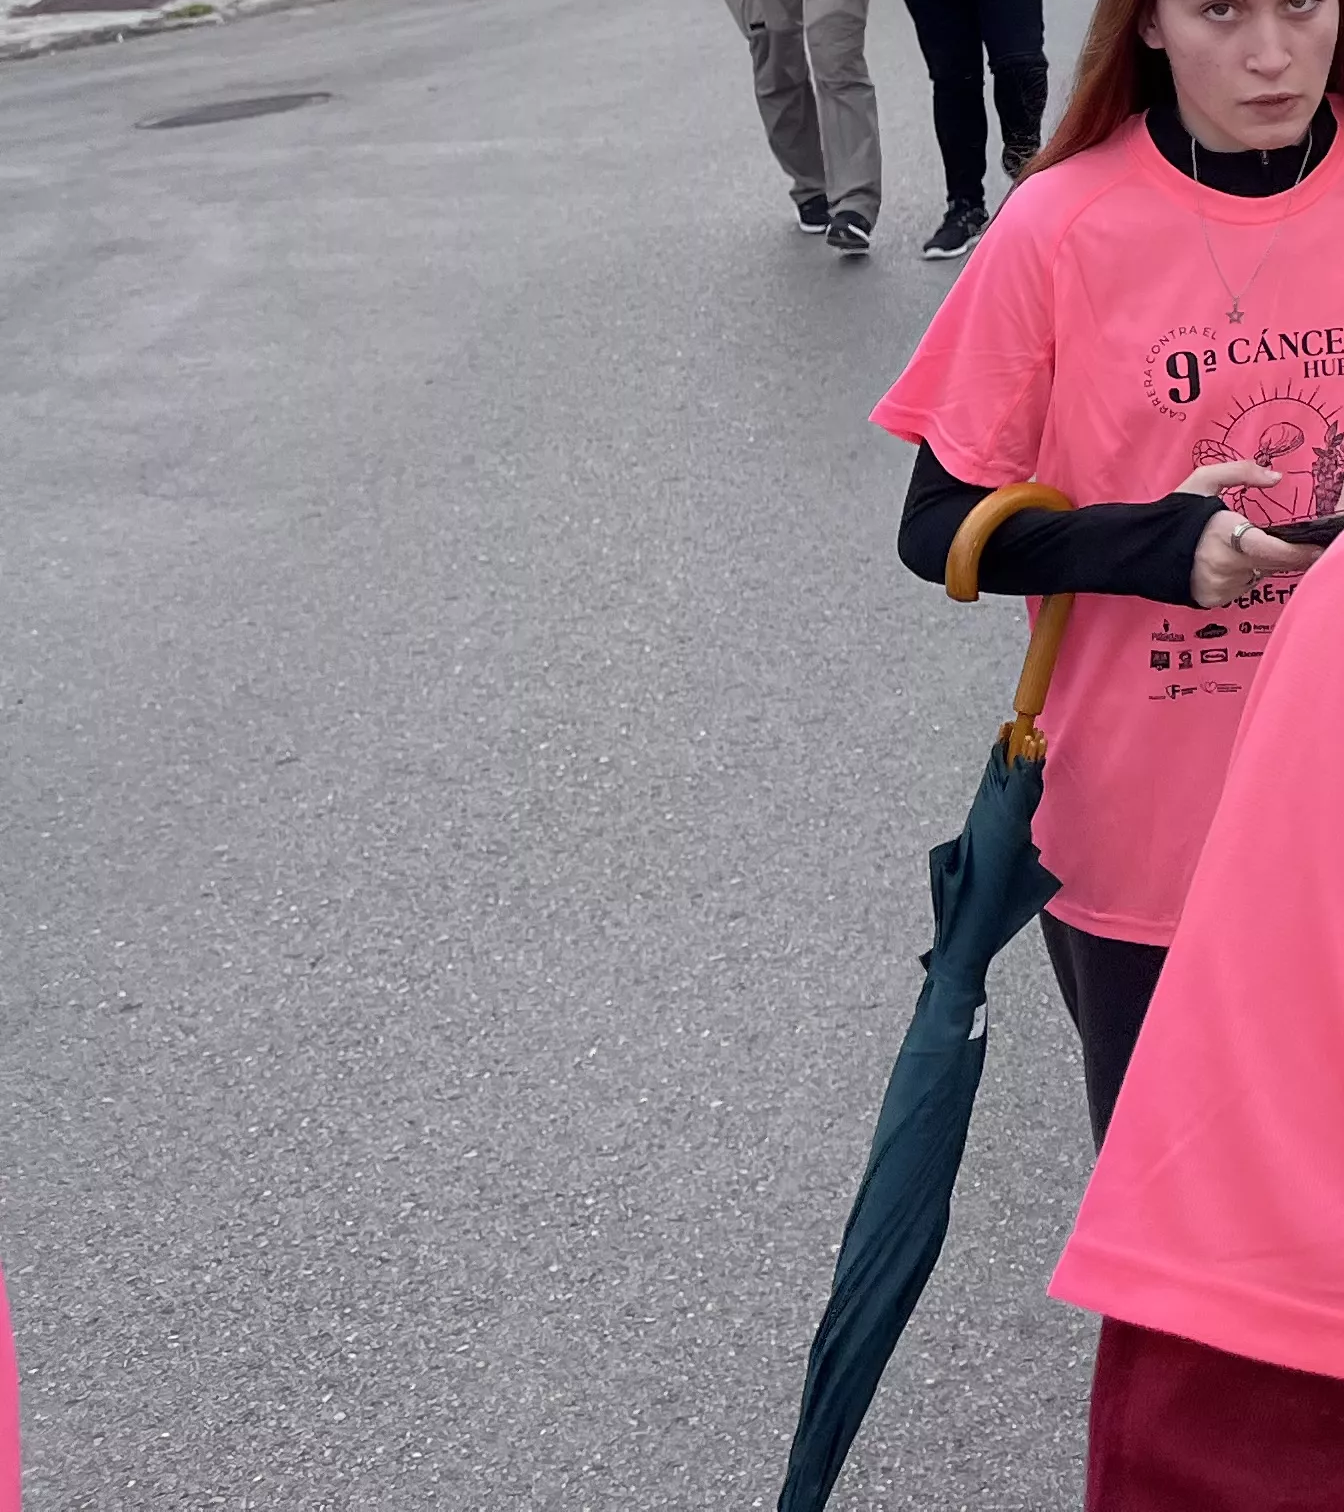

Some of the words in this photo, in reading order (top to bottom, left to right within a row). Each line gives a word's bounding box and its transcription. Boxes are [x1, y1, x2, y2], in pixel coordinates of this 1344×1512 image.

[1145, 325, 1199, 365] CONTRA
[1201, 325, 1218, 341] EL
[1143, 368, 1188, 423] CARRERA
[1165, 348, 1218, 405] 9ª
